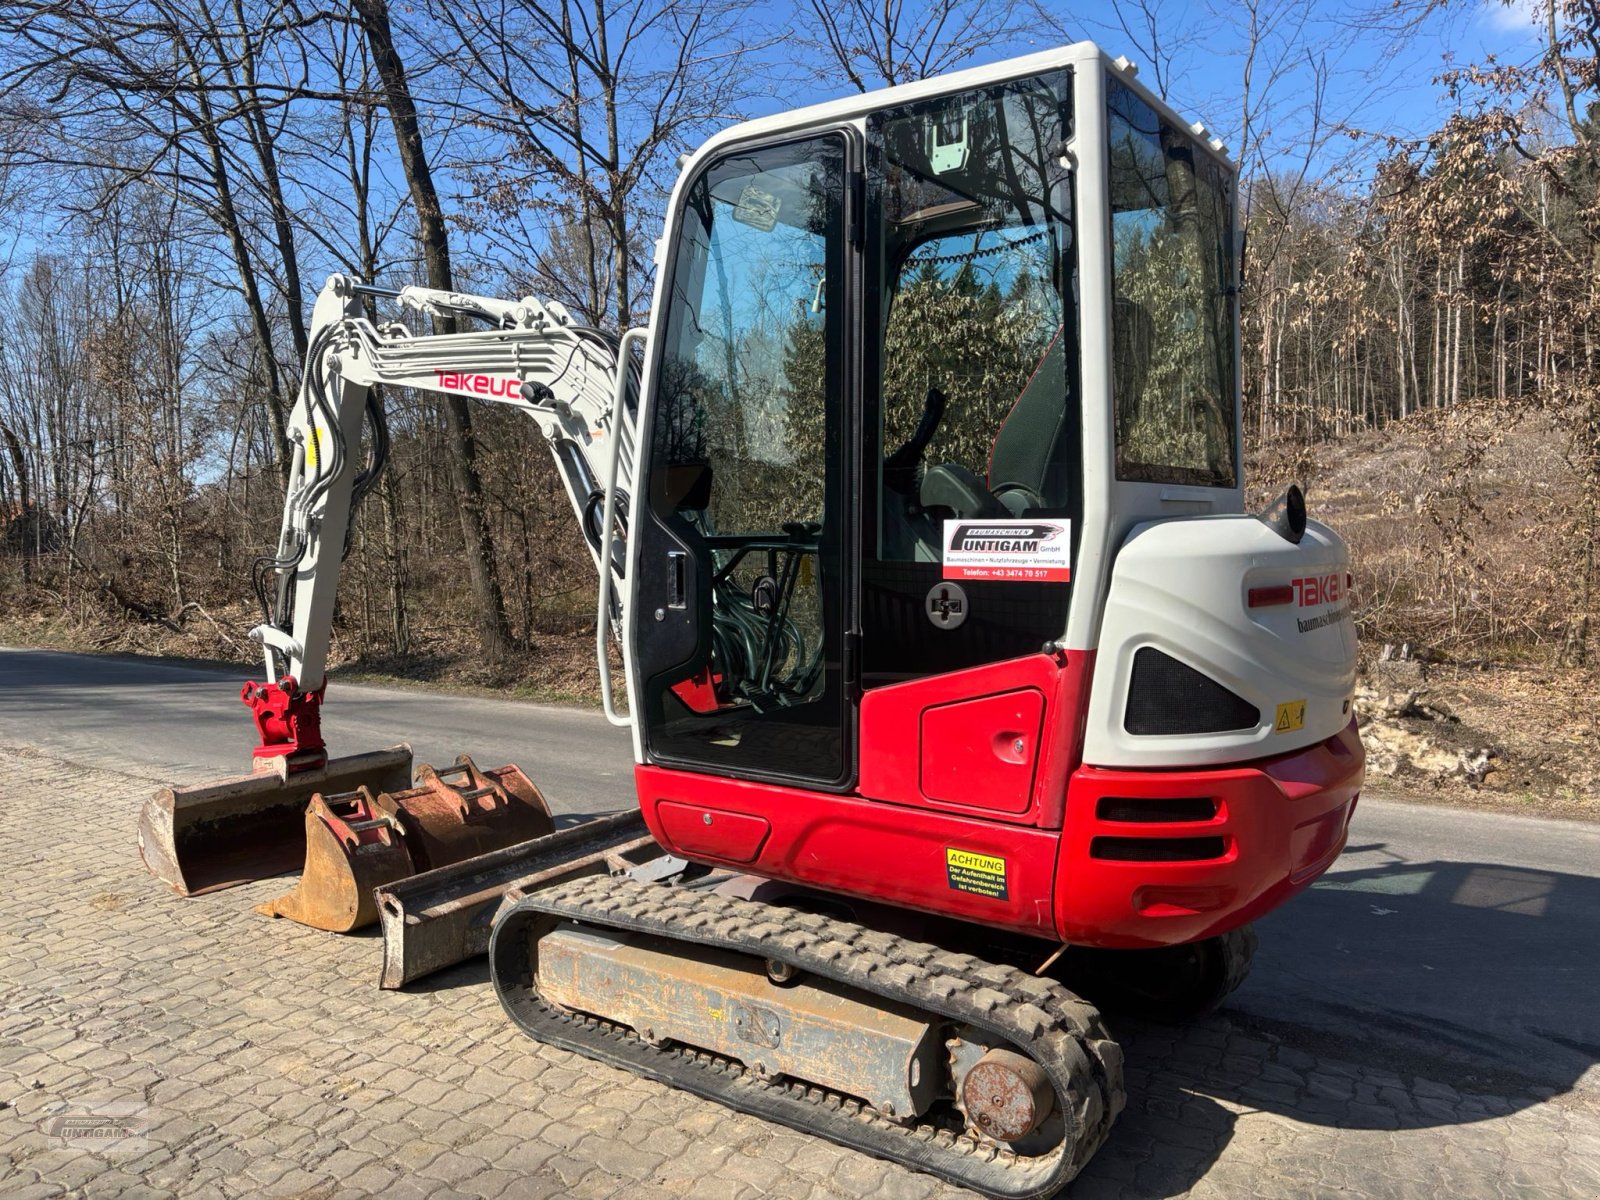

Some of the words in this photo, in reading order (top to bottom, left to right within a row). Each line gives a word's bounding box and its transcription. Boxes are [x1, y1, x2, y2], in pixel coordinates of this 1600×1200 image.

[969, 528, 1030, 536] BAUMASCHINEN
[963, 568, 990, 576] Telefon:
[992, 569, 1004, 577] +43
[1006, 569, 1023, 577] 3474
[1035, 570, 1048, 578] 517
[950, 853, 1002, 871] ACHTUNG
[962, 869, 996, 881] Aufenthalt
[951, 874, 1005, 891] Gefahrenbereich
[968, 886, 999, 897] verboten!
